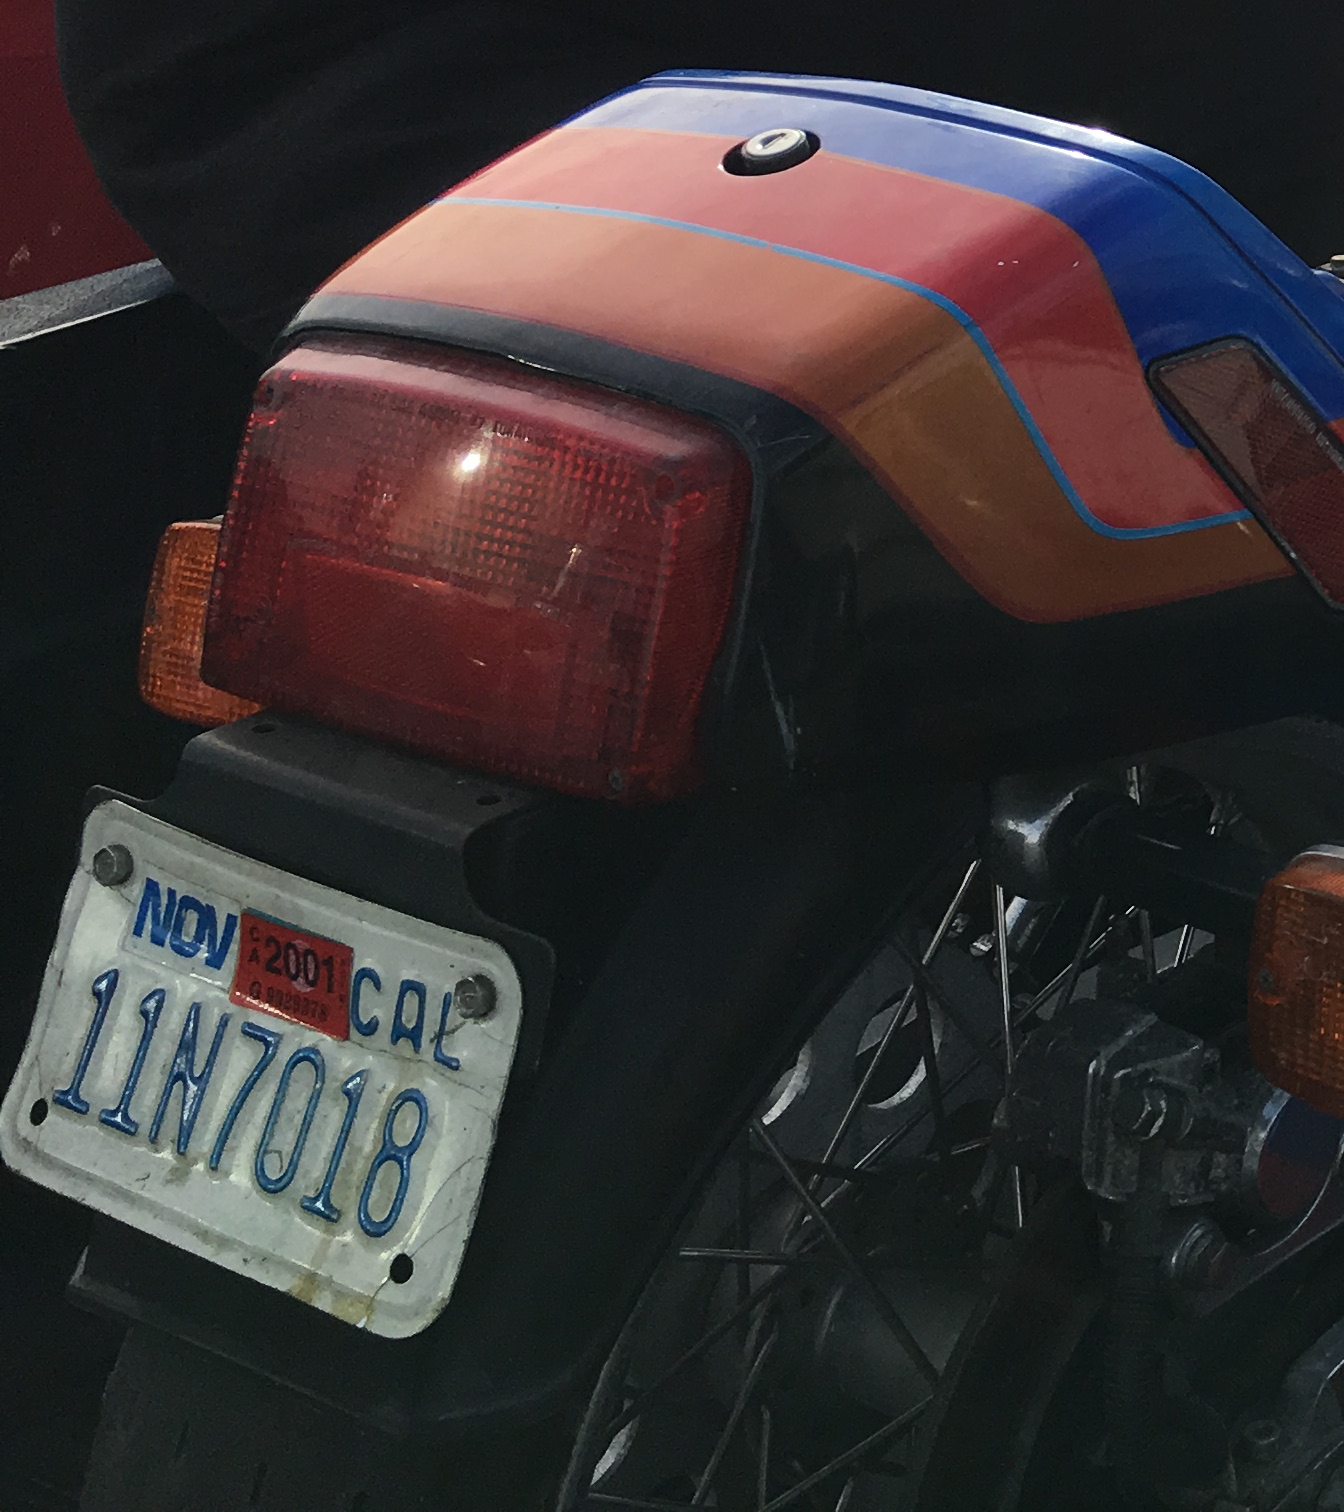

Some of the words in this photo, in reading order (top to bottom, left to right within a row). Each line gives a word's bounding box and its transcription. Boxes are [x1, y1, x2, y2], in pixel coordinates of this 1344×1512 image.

[132, 877, 238, 970] NOV
[265, 935, 335, 994] 2001
[351, 967, 462, 1072] CAL
[53, 969, 430, 1238] 11N7018
